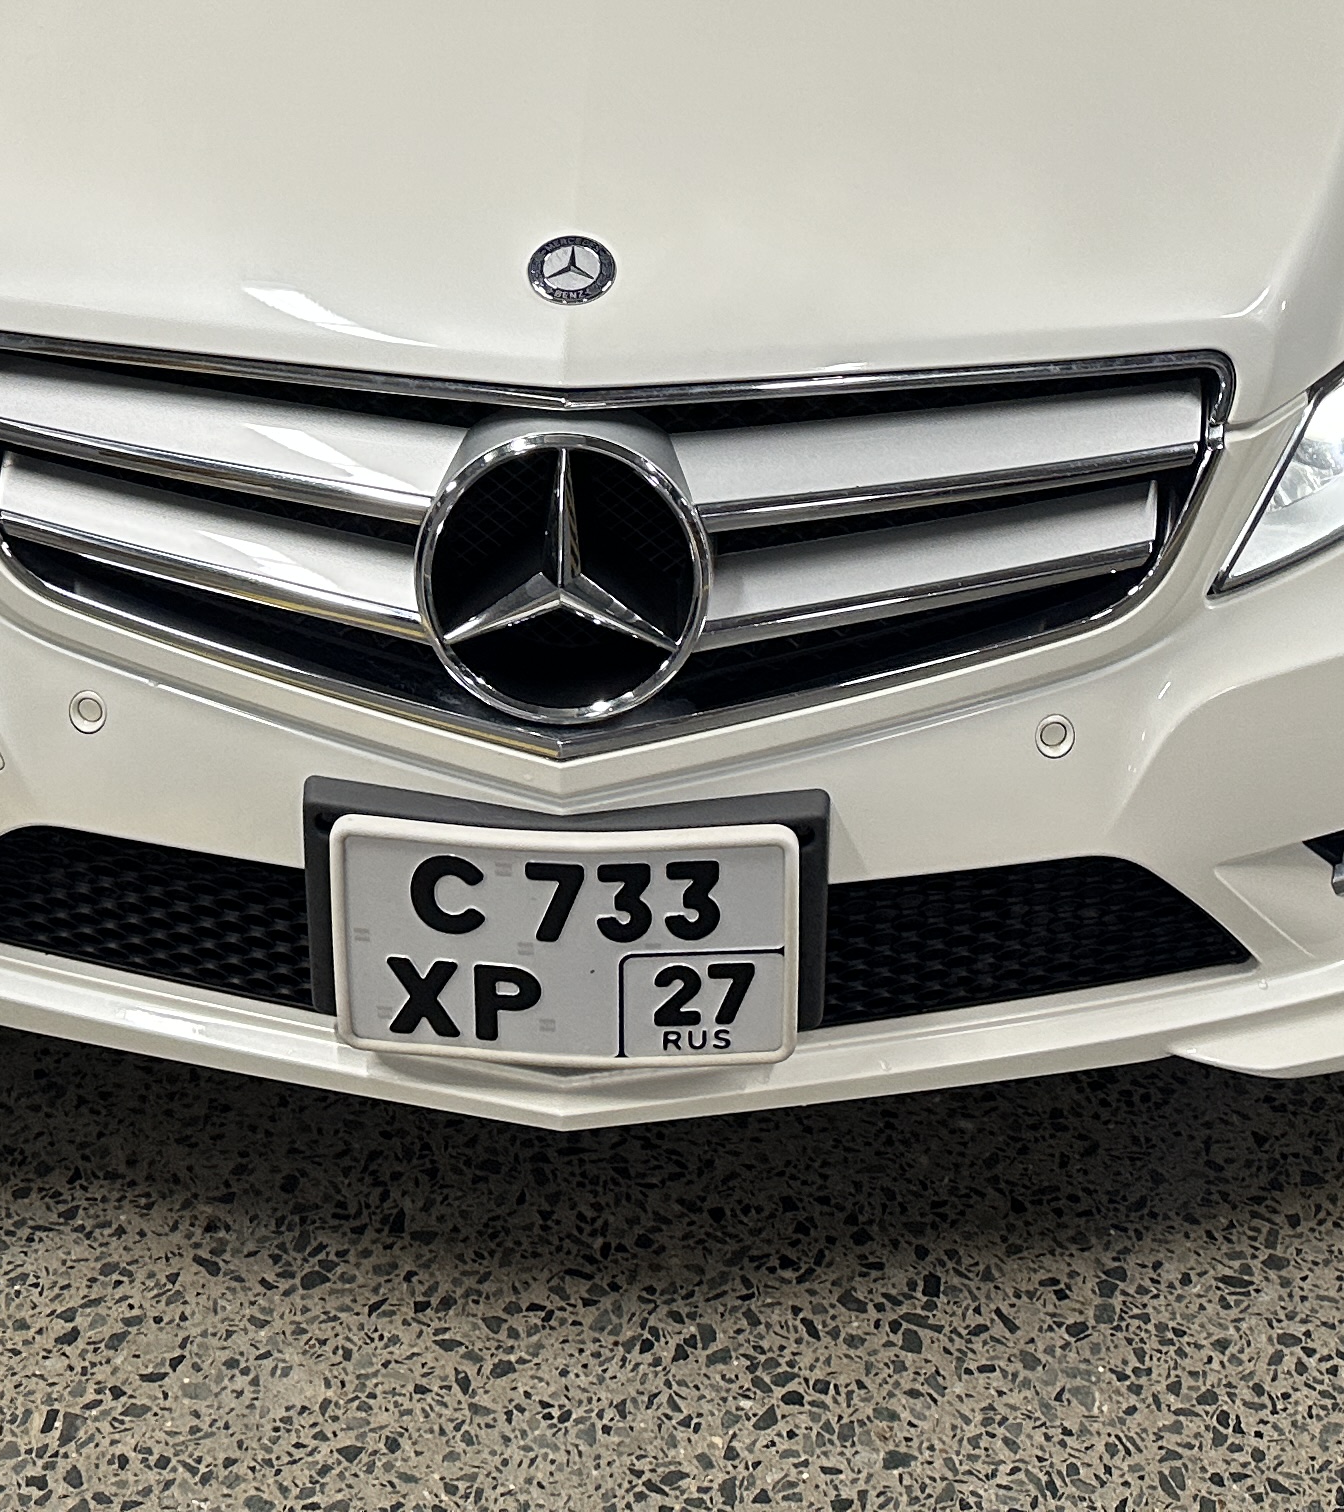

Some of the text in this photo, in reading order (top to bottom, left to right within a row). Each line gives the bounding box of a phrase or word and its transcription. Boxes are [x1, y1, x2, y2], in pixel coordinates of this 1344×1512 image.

[545, 237, 599, 252] MERCEDES
[554, 290, 585, 299] BENZ
[409, 854, 721, 943] C 733
[386, 955, 543, 1042] XP
[653, 962, 756, 1027] 27
[662, 1029, 733, 1051] RUS
